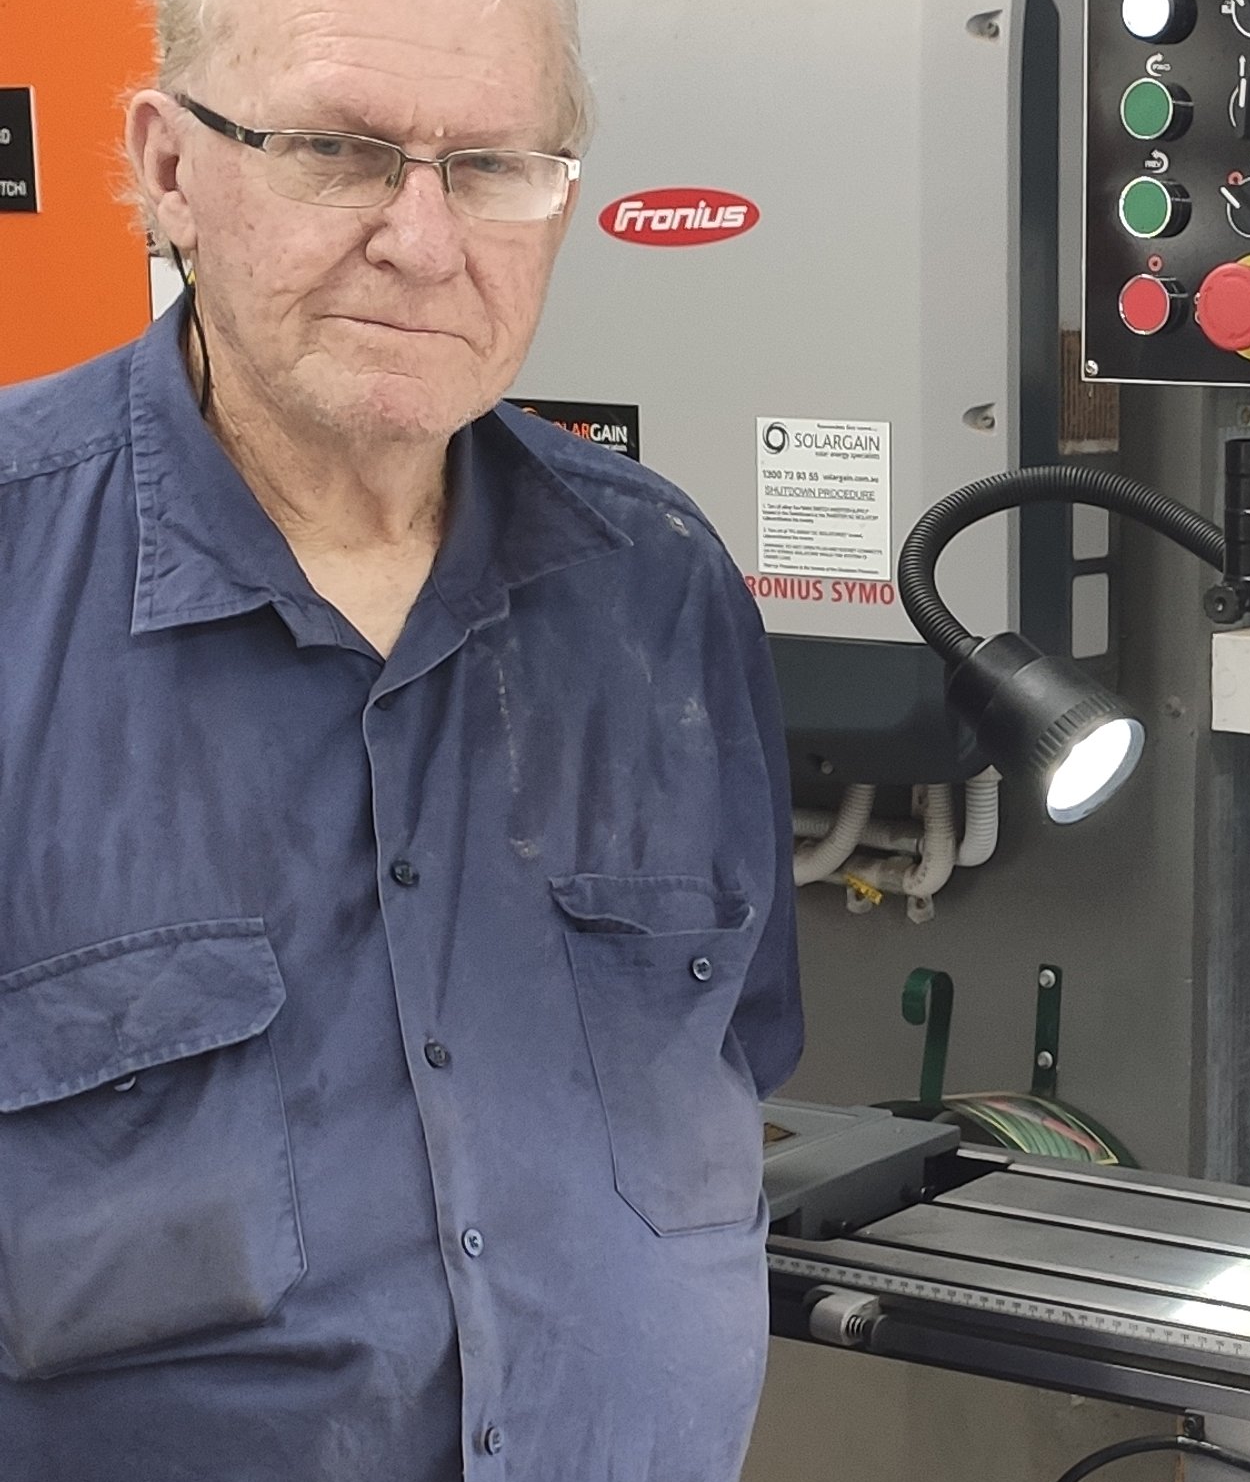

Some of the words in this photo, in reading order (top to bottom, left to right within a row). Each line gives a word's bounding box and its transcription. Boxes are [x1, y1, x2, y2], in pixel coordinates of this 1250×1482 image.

[613, 200, 748, 232] Fronius
[553, 421, 628, 443] ARGAIN
[794, 432, 881, 451] SOLARGAIN
[764, 485, 817, 498] SHUTDOWN
[818, 487, 876, 501] PROCEDURE
[744, 576, 824, 601] RONIUS
[830, 581, 895, 605] SYMO
